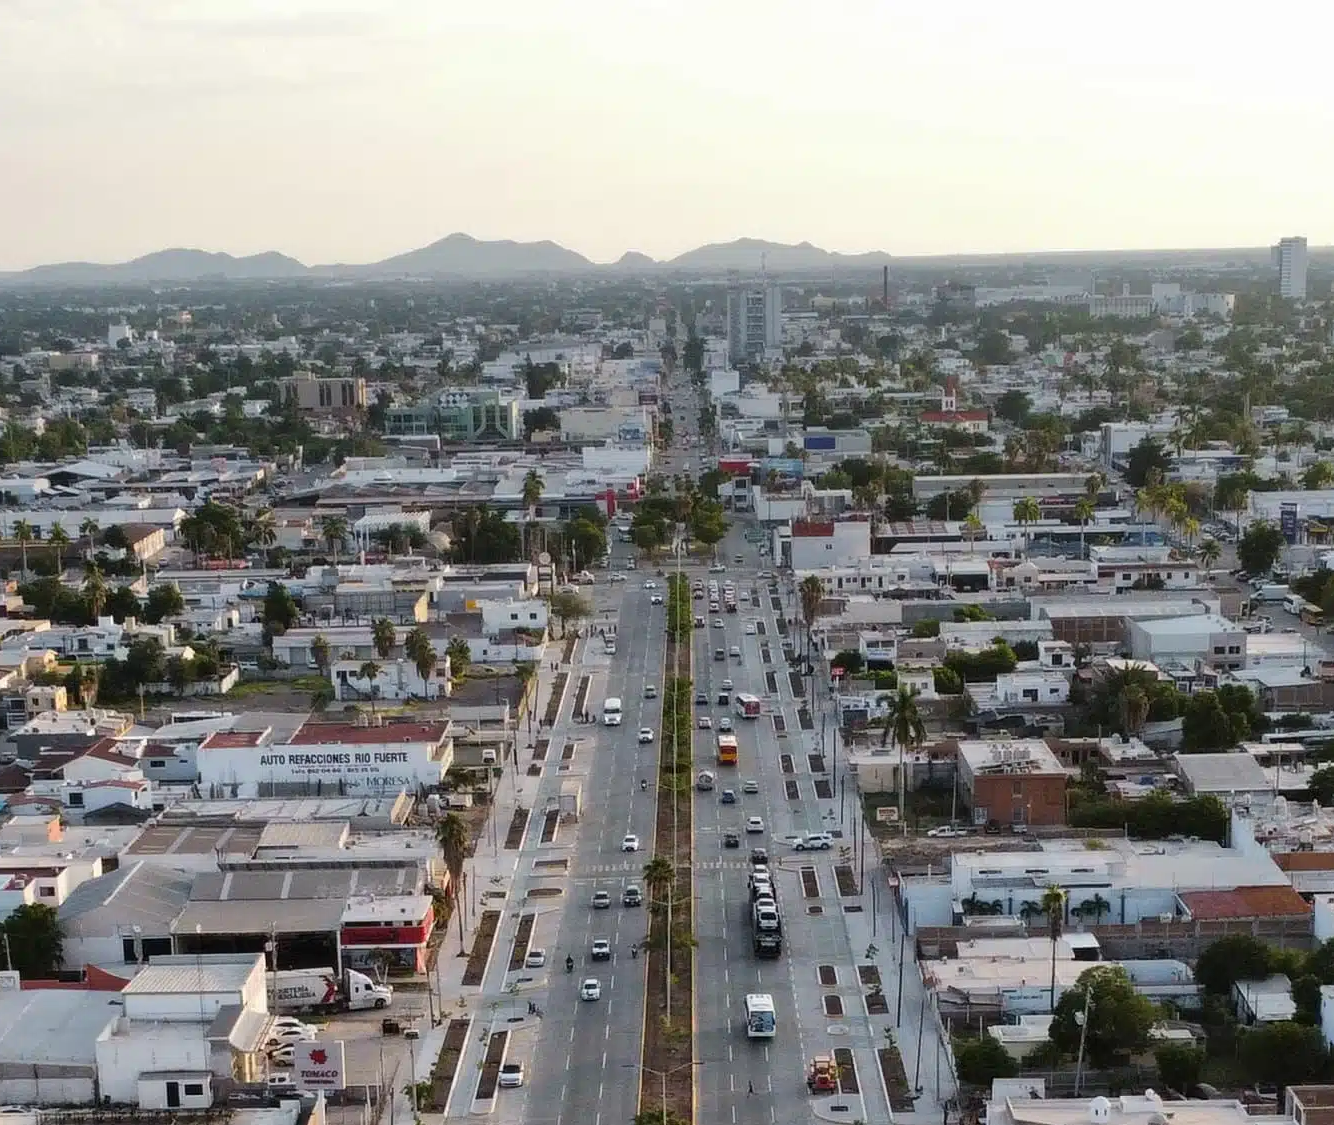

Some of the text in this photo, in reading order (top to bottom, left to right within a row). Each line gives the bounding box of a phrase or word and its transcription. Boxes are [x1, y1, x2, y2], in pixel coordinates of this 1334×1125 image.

[260, 755, 285, 765] AUTO
[289, 753, 350, 764] REFACCIONES
[374, 752, 408, 763] FUERTE
[366, 776, 410, 786] MORESA
[300, 1070, 338, 1078] TOMACO
